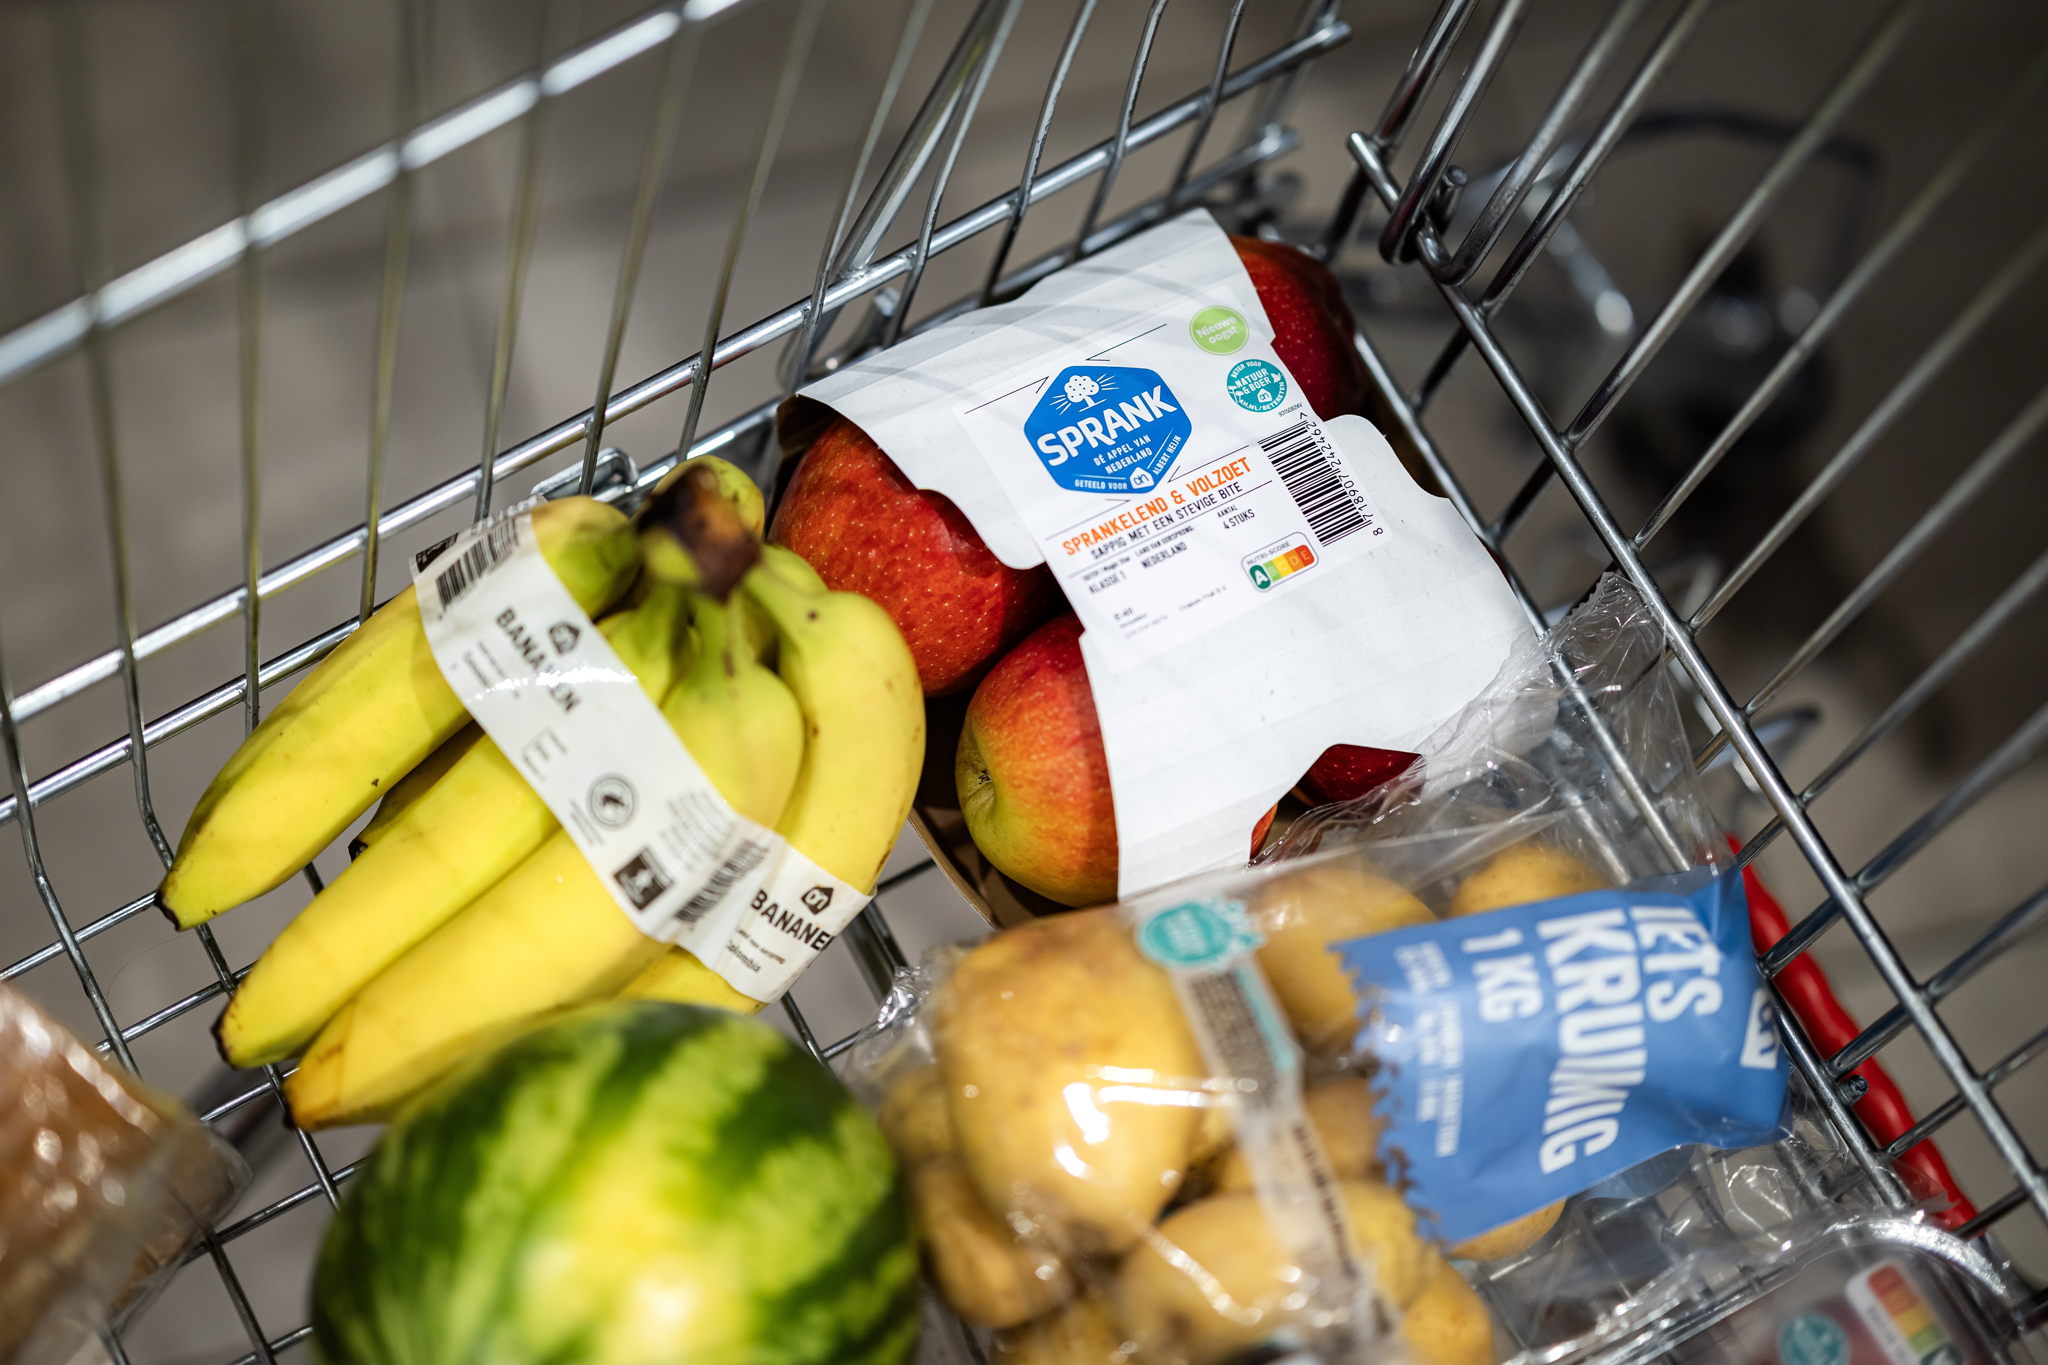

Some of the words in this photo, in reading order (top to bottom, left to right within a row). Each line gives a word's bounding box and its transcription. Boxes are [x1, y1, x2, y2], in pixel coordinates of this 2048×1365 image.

[1197, 317, 1236, 337] Nieuwe
[1209, 326, 1238, 343] oogst
[1231, 363, 1246, 378] BETER
[1234, 368, 1269, 388] NATUUR
[1242, 386, 1251, 394] &
[1248, 376, 1272, 392] BOER
[1036, 384, 1178, 467] SPRANK
[1093, 453, 1106, 466] DÉ
[1106, 443, 1134, 461] APPEL
[1132, 434, 1152, 448] VAN
[1152, 452, 1171, 476] ALBERT
[1166, 434, 1182, 454] HEIJN
[1306, 421, 1342, 468] 242462
[1104, 447, 1153, 475] NEDERLAND
[1074, 479, 1106, 490] GETEELD
[1107, 482, 1128, 490] VOOR
[1338, 473, 1374, 521] 718907
[1062, 496, 1170, 556] SPRANKELEND
[1170, 490, 1187, 504] &
[1186, 456, 1252, 497] VOLZOET
[1217, 505, 1239, 518] AANTAL
[1222, 519, 1231, 530] 4
[1230, 508, 1256, 528] STUKS
[1091, 536, 1127, 560] SAPPIG
[1128, 524, 1150, 541] MET
[1153, 513, 1175, 531] EEN
[1178, 493, 1218, 520] STEVIGE
[1218, 481, 1243, 500] BITE
[1372, 527, 1384, 537] 8
[1141, 541, 1188, 569] NEDERLAND
[1254, 569, 1269, 586] A
[495, 606, 582, 714] BANAEN
[1460, 927, 1524, 954] 1
[1629, 905, 1723, 1023] IETS
[1471, 953, 1544, 1024] KG
[1535, 907, 1647, 1175] KRUIMIG
